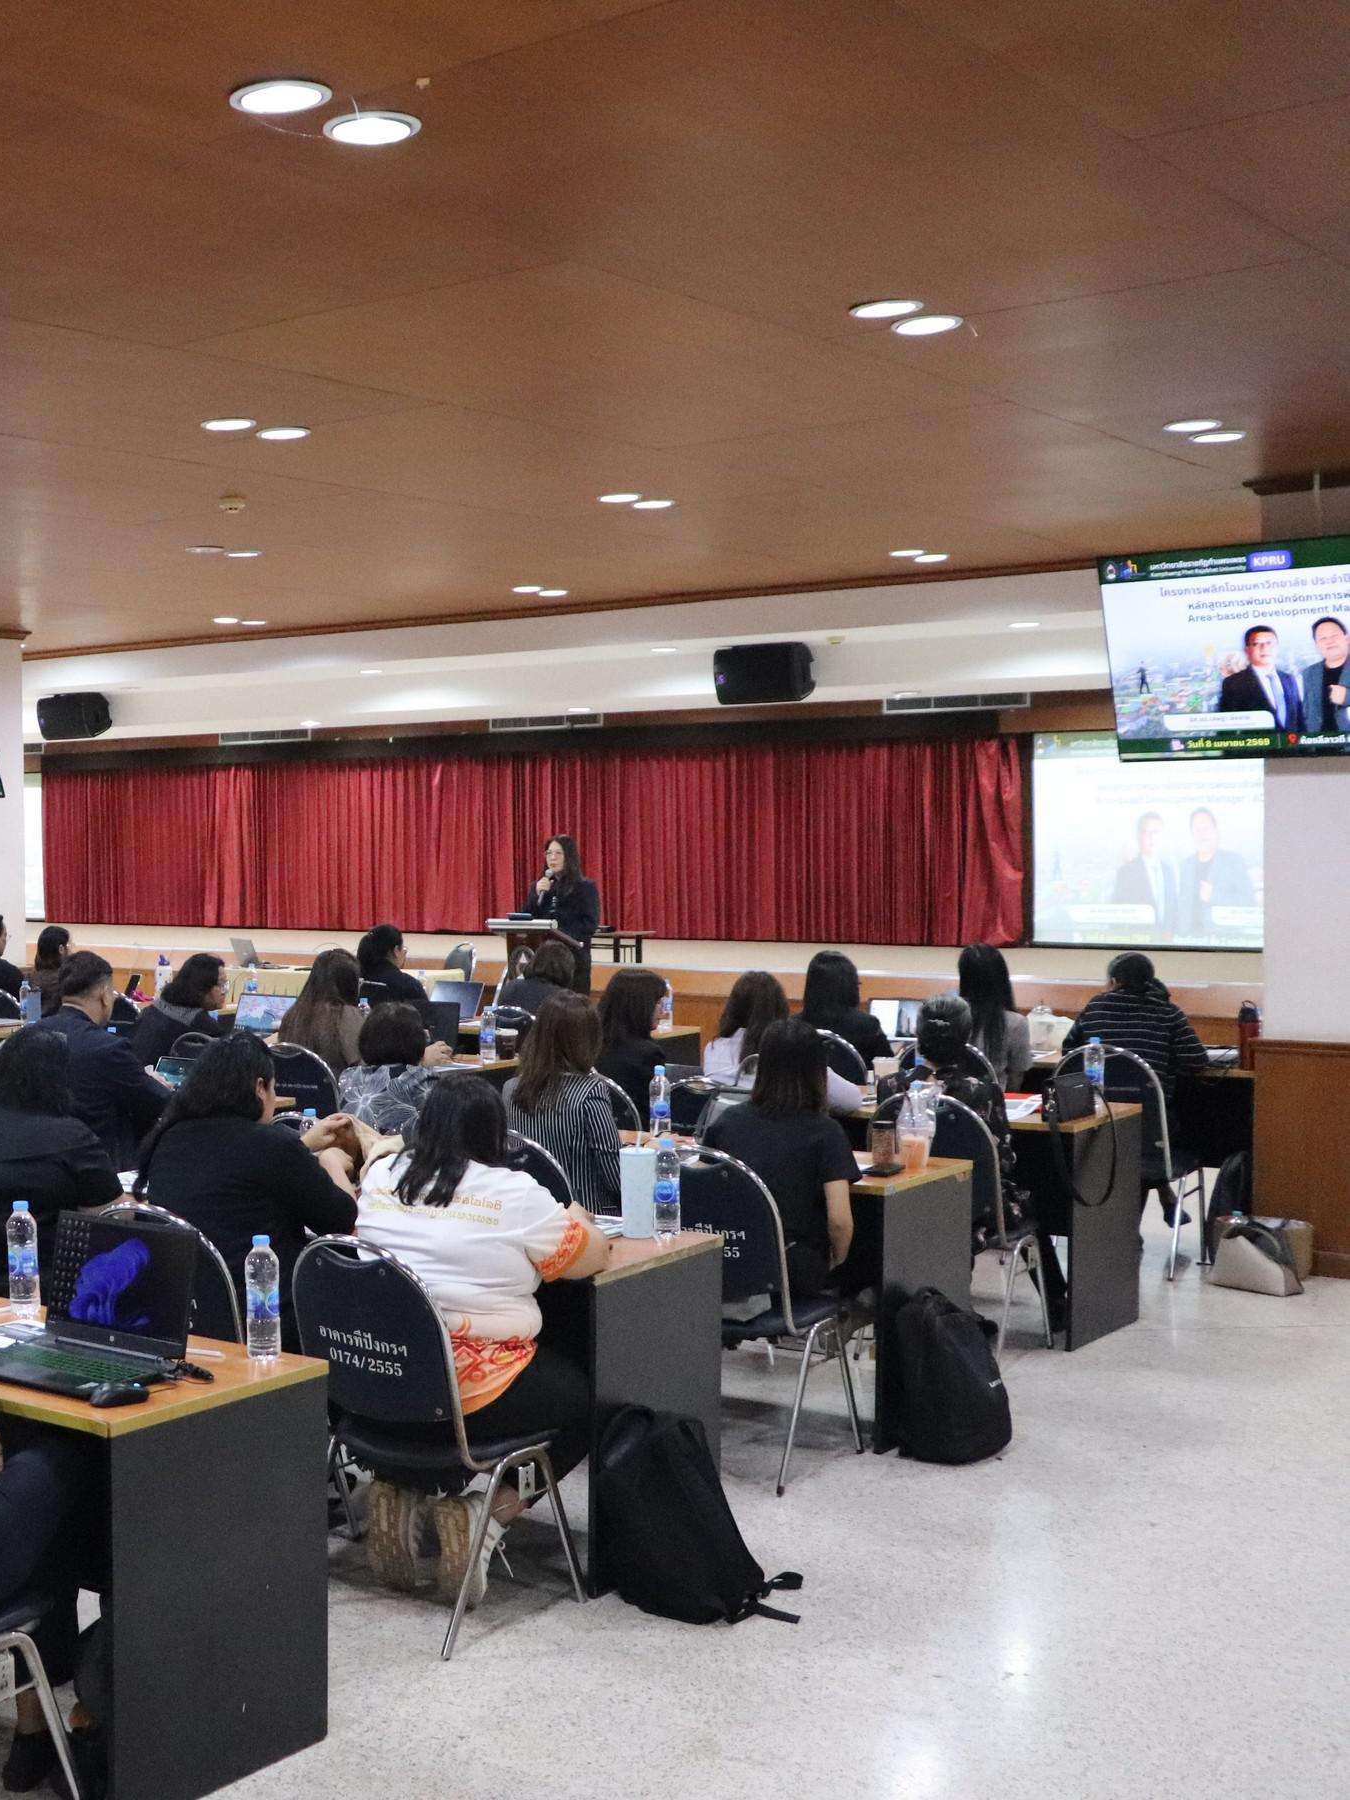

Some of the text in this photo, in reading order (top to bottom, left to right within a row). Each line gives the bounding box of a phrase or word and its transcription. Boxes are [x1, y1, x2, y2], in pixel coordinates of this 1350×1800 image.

[1253, 554, 1285, 567] KPRU
[1188, 610, 1250, 623] Area-based
[1252, 605, 1330, 618] Development
[1246, 737, 1270, 746] 2569
[329, 1347, 403, 1377] 0174/2555
